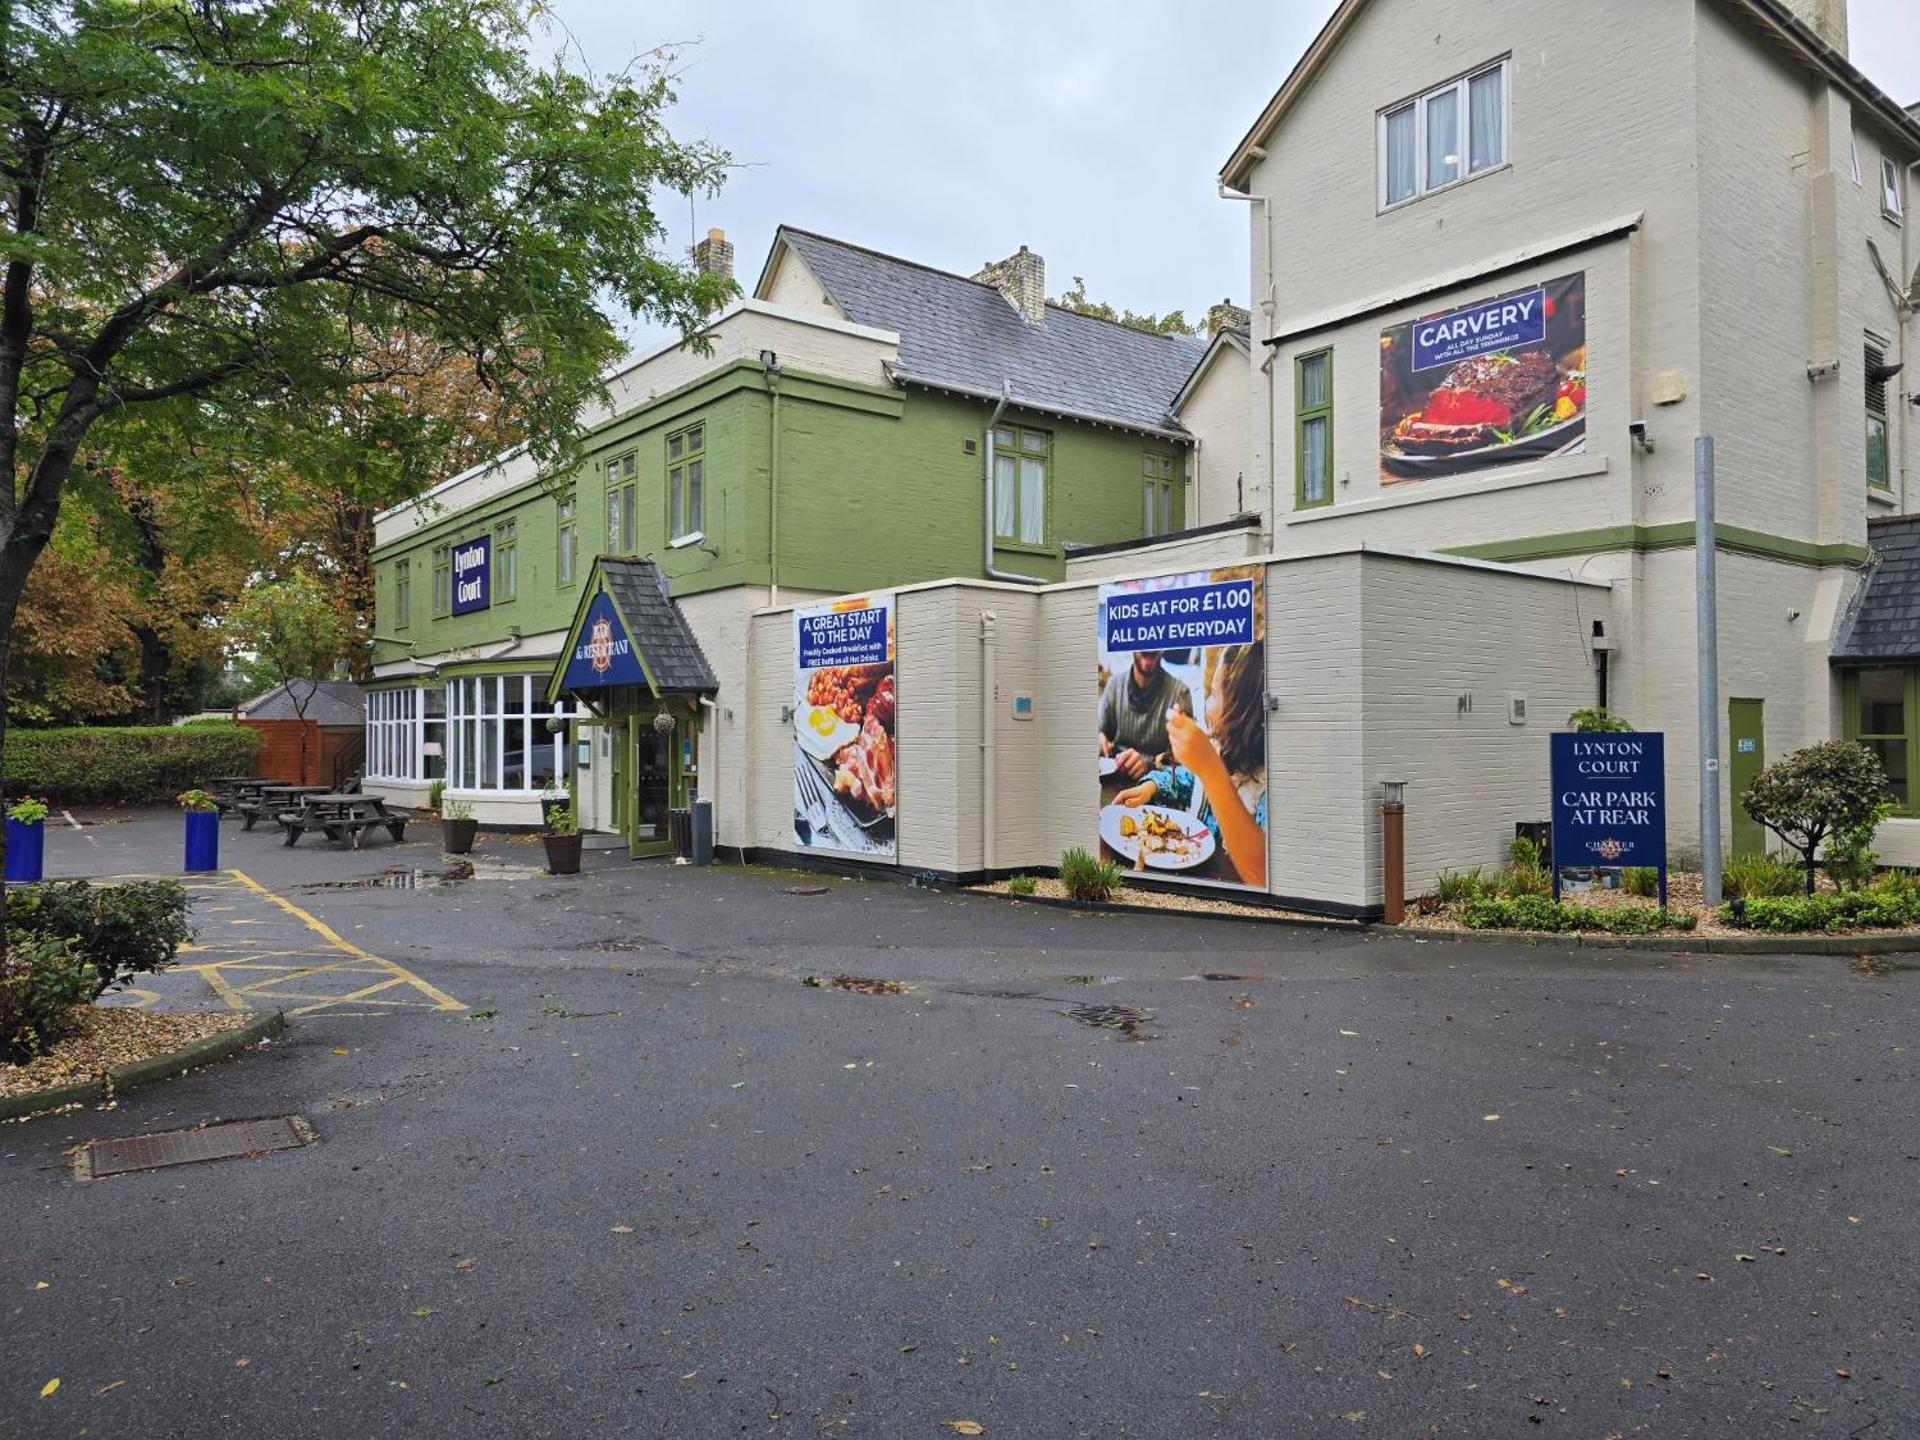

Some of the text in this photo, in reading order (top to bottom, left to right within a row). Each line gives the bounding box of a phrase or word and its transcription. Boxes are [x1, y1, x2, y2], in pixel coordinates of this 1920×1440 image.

[1419, 299, 1535, 347] CARVERY
[1434, 334, 1520, 360] WITH ALL THE TRIMMINGS
[1446, 331, 1504, 352] ALL DAY SUNDAY
[455, 546, 485, 578] Lynton
[458, 576, 482, 603] Court
[1109, 588, 1250, 620] KIDS EAT FOR £1.00
[804, 610, 882, 632] A GREAT START
[1110, 618, 1247, 644] ALL DAY EVERYDAY
[812, 626, 872, 645] TO THE DAY
[576, 646, 582, 660] &
[822, 646, 842, 655] Cooked
[869, 642, 882, 650] with
[808, 658, 820, 666] FREE
[1574, 742, 1642, 755] LYNTON
[1578, 761, 1640, 774] COURT
[1562, 792, 1656, 807] CAR PARK
[1571, 810, 1650, 825] AT REAR
